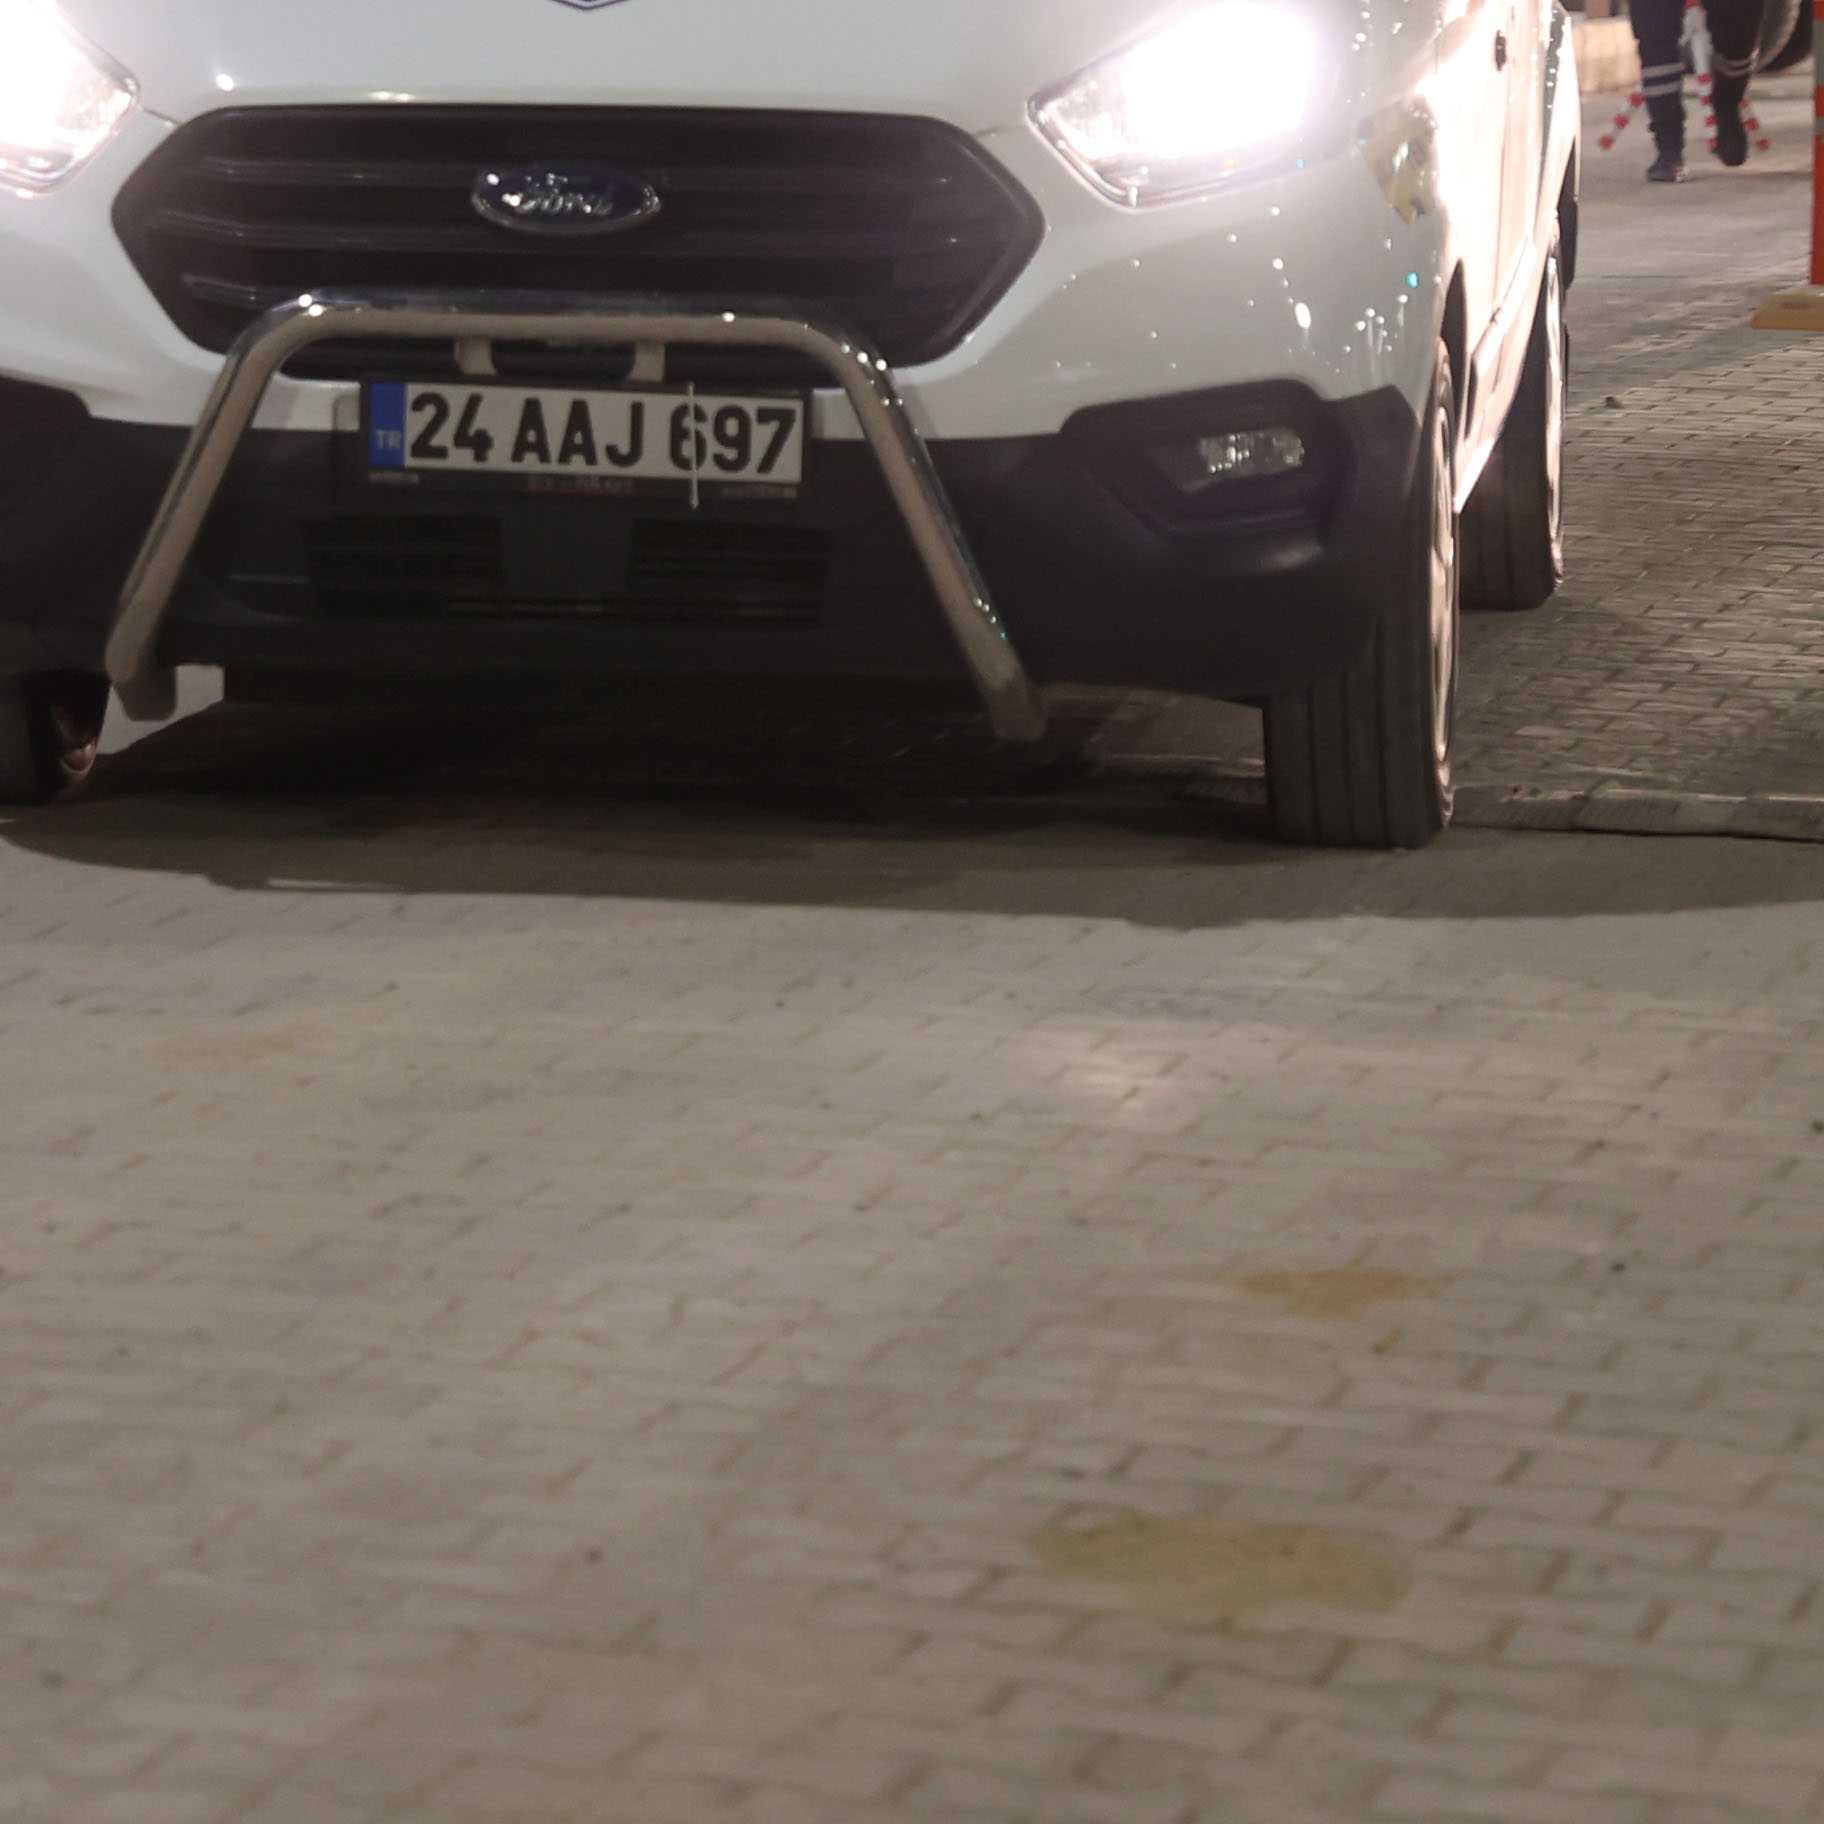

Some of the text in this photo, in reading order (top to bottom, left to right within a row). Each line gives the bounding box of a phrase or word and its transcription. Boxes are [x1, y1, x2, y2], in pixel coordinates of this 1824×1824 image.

[375, 391, 797, 476] TR 24 AAJ 697
